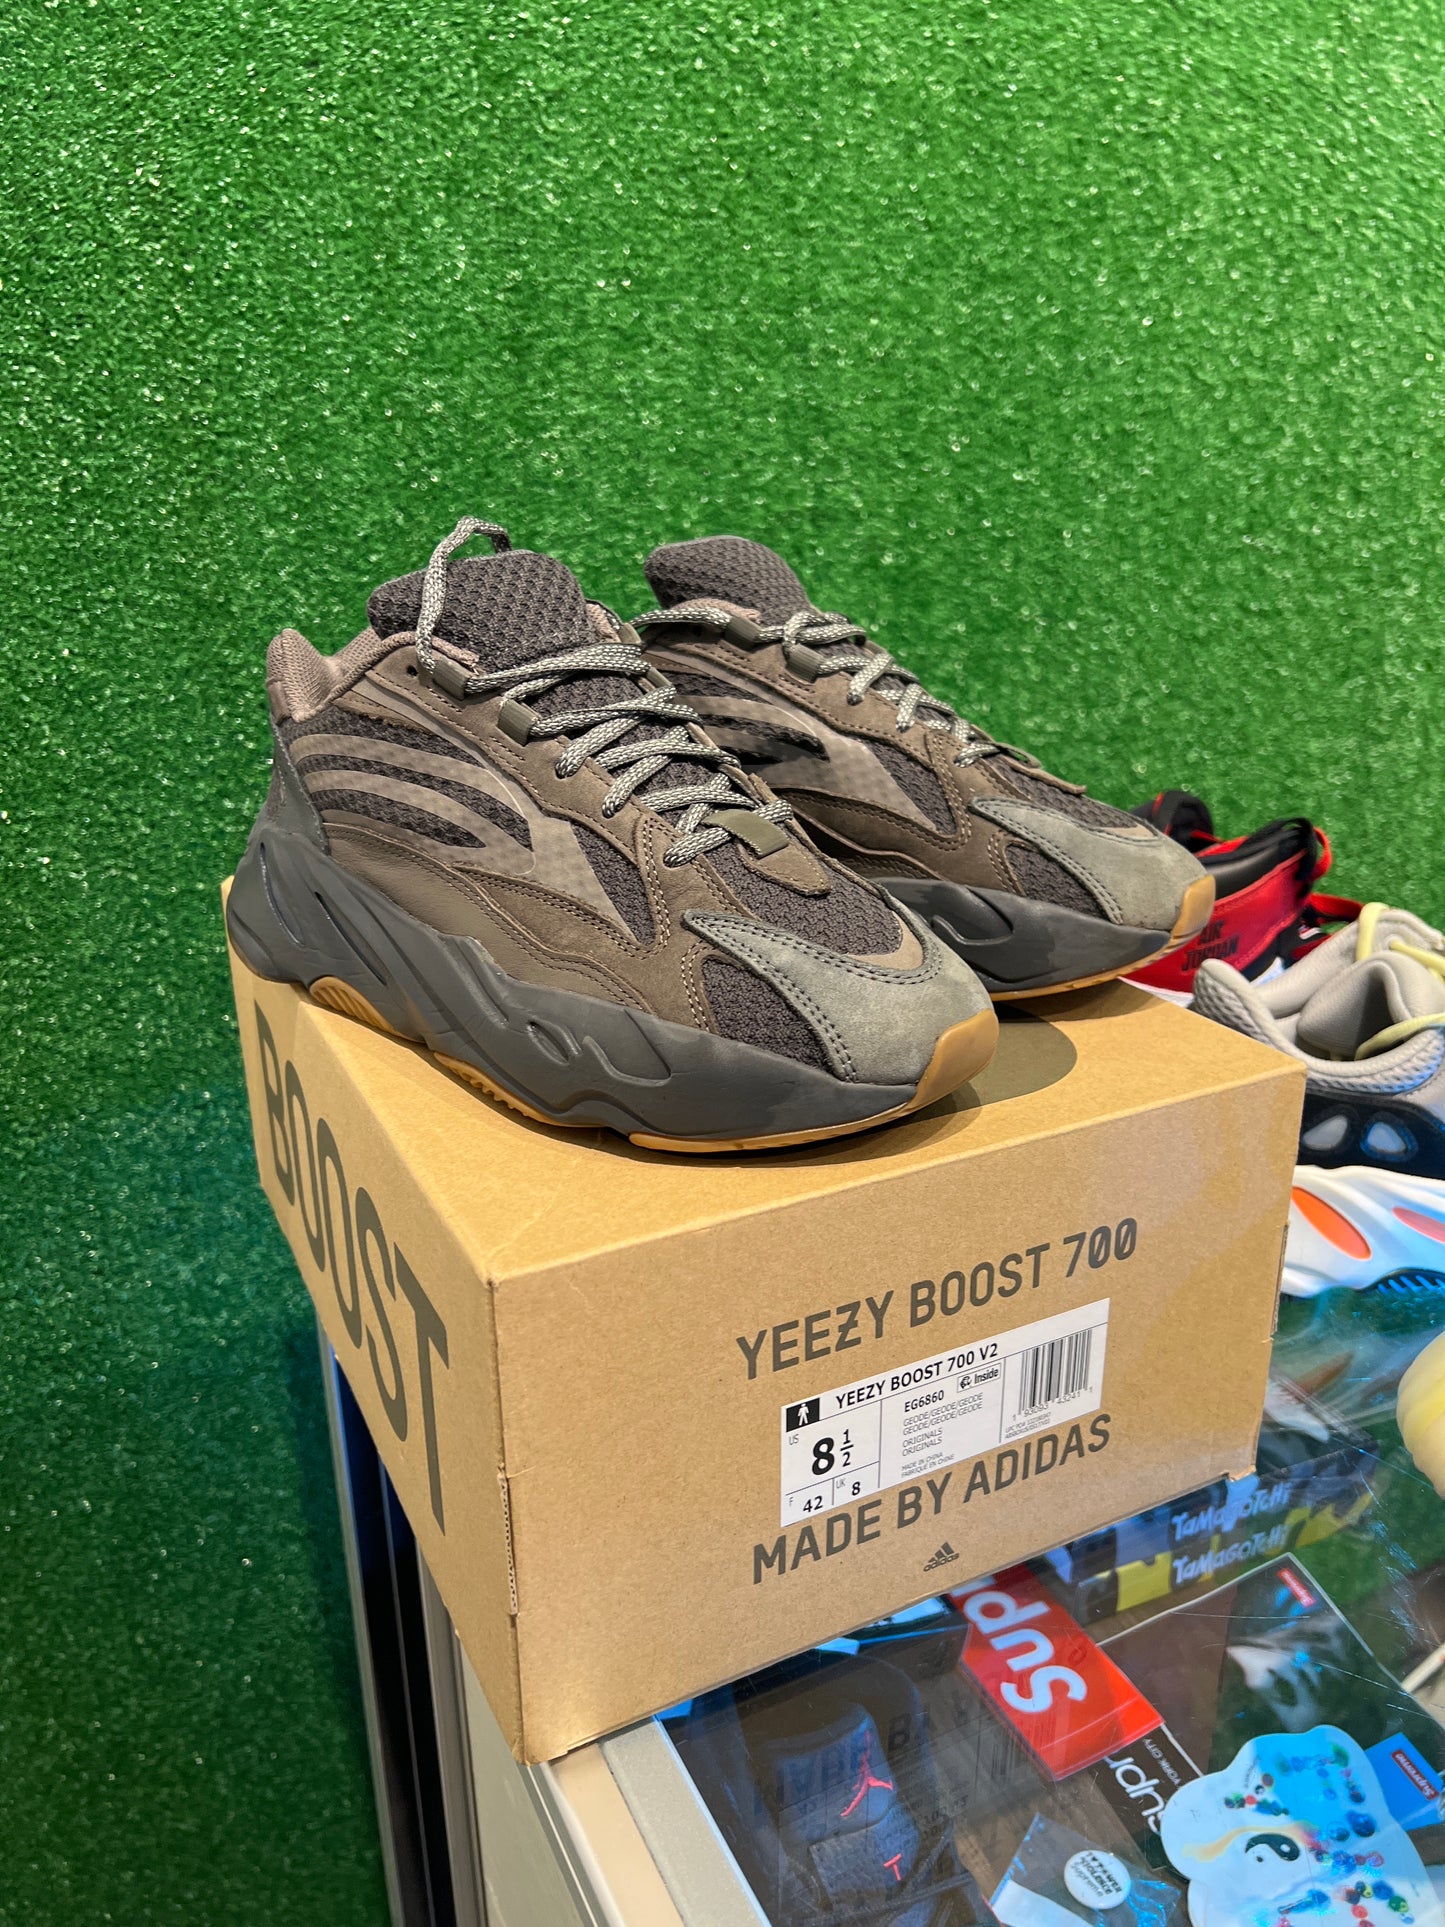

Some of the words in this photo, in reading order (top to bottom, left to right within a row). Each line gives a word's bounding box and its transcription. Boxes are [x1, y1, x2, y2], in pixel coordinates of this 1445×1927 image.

[254, 998, 450, 1537] BOOST
[736, 1290, 895, 1381] YEEZY
[909, 1242, 1050, 1328] BOOST
[1063, 1217, 1138, 1278] 700
[836, 1380, 886, 1410] YEEZY
[890, 1361, 943, 1391] BOOST
[947, 1351, 975, 1372] 700
[979, 1343, 999, 1361] V2
[974, 1367, 999, 1385] Inside
[904, 1389, 945, 1413] EG6860
[789, 1433, 799, 1446] US
[902, 1427, 943, 1448] ORIGINALS
[902, 1436, 943, 1457] ORIGINALS
[811, 1437, 835, 1476] 8
[836, 1478, 847, 1490] UK
[852, 1481, 861, 1496] 8
[753, 1499, 883, 1585] MADE
[897, 1472, 952, 1529] BY
[963, 1413, 1112, 1503] ADIDAS
[803, 1495, 823, 1513] 42
